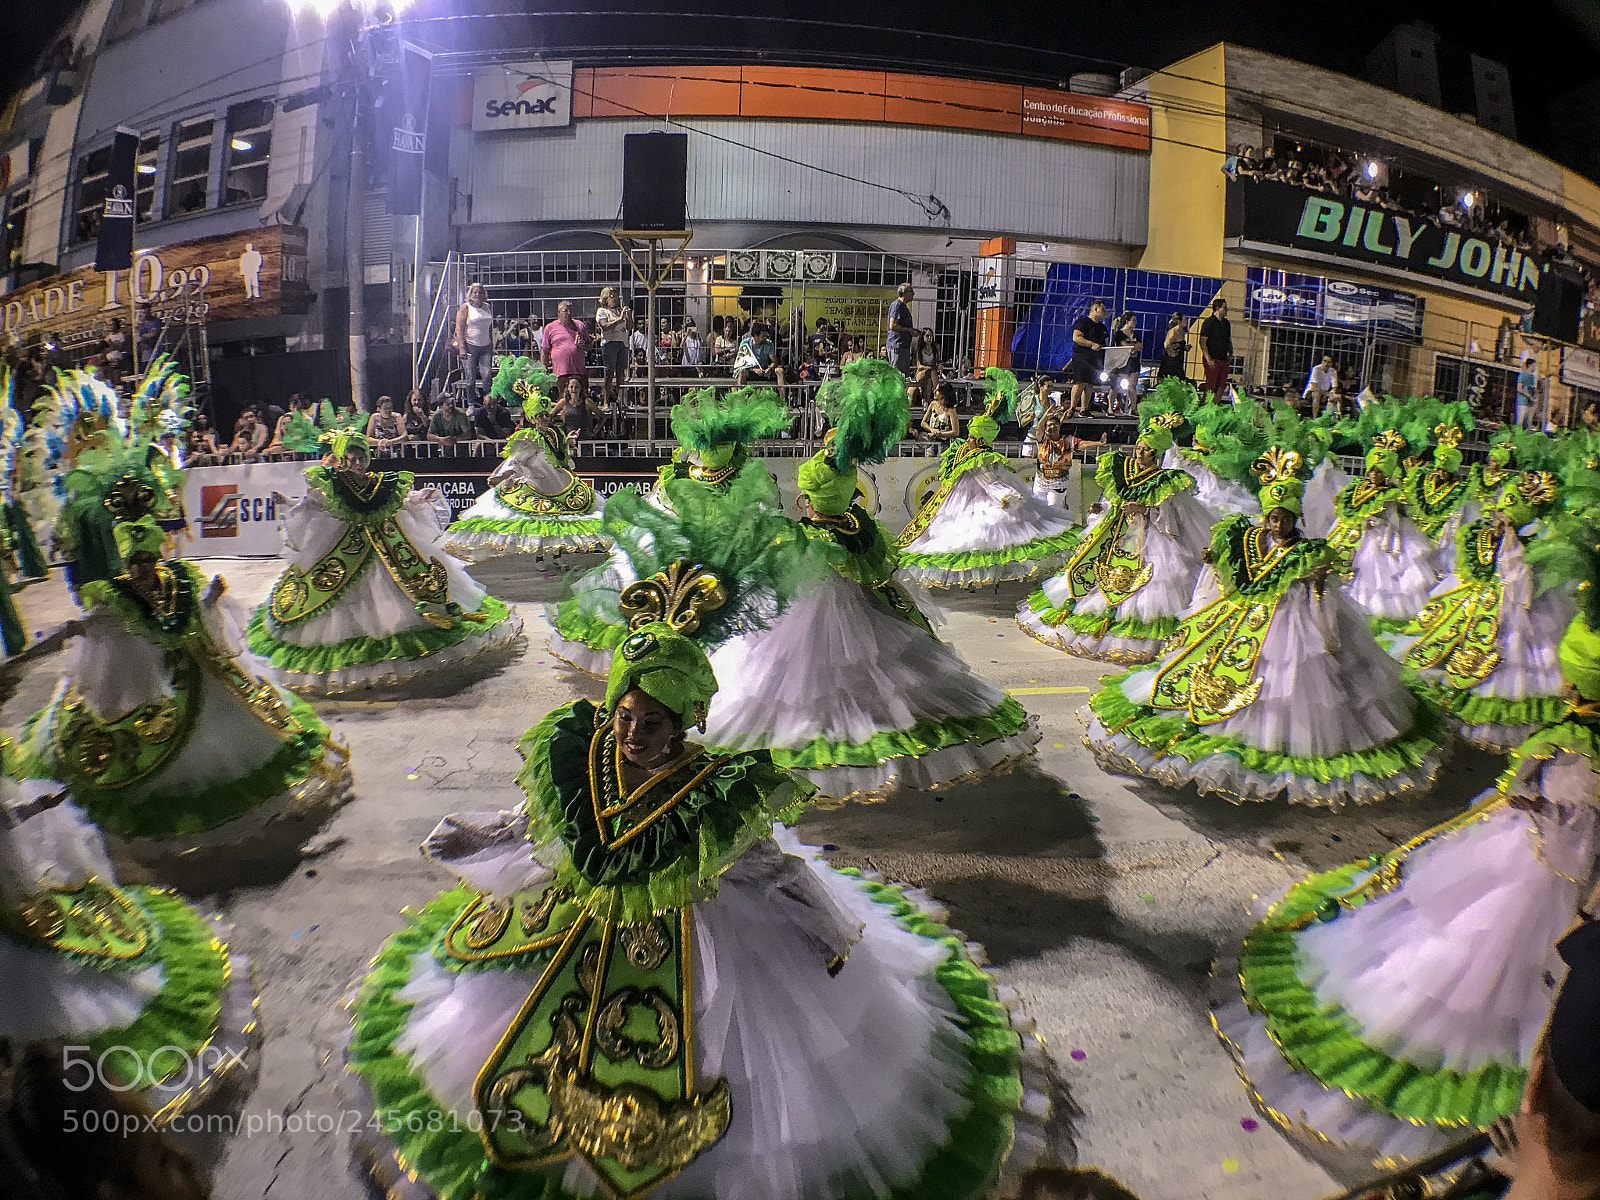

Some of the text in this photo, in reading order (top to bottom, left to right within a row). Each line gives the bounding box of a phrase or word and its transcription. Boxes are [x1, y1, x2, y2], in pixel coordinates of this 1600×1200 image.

[1023, 99, 1149, 127] Centro de Educação Profissional
[393, 130, 425, 150] HAVAN
[1297, 196, 1427, 260] BILY
[0, 279, 85, 334] DADE
[446, 498, 460, 509] RO
